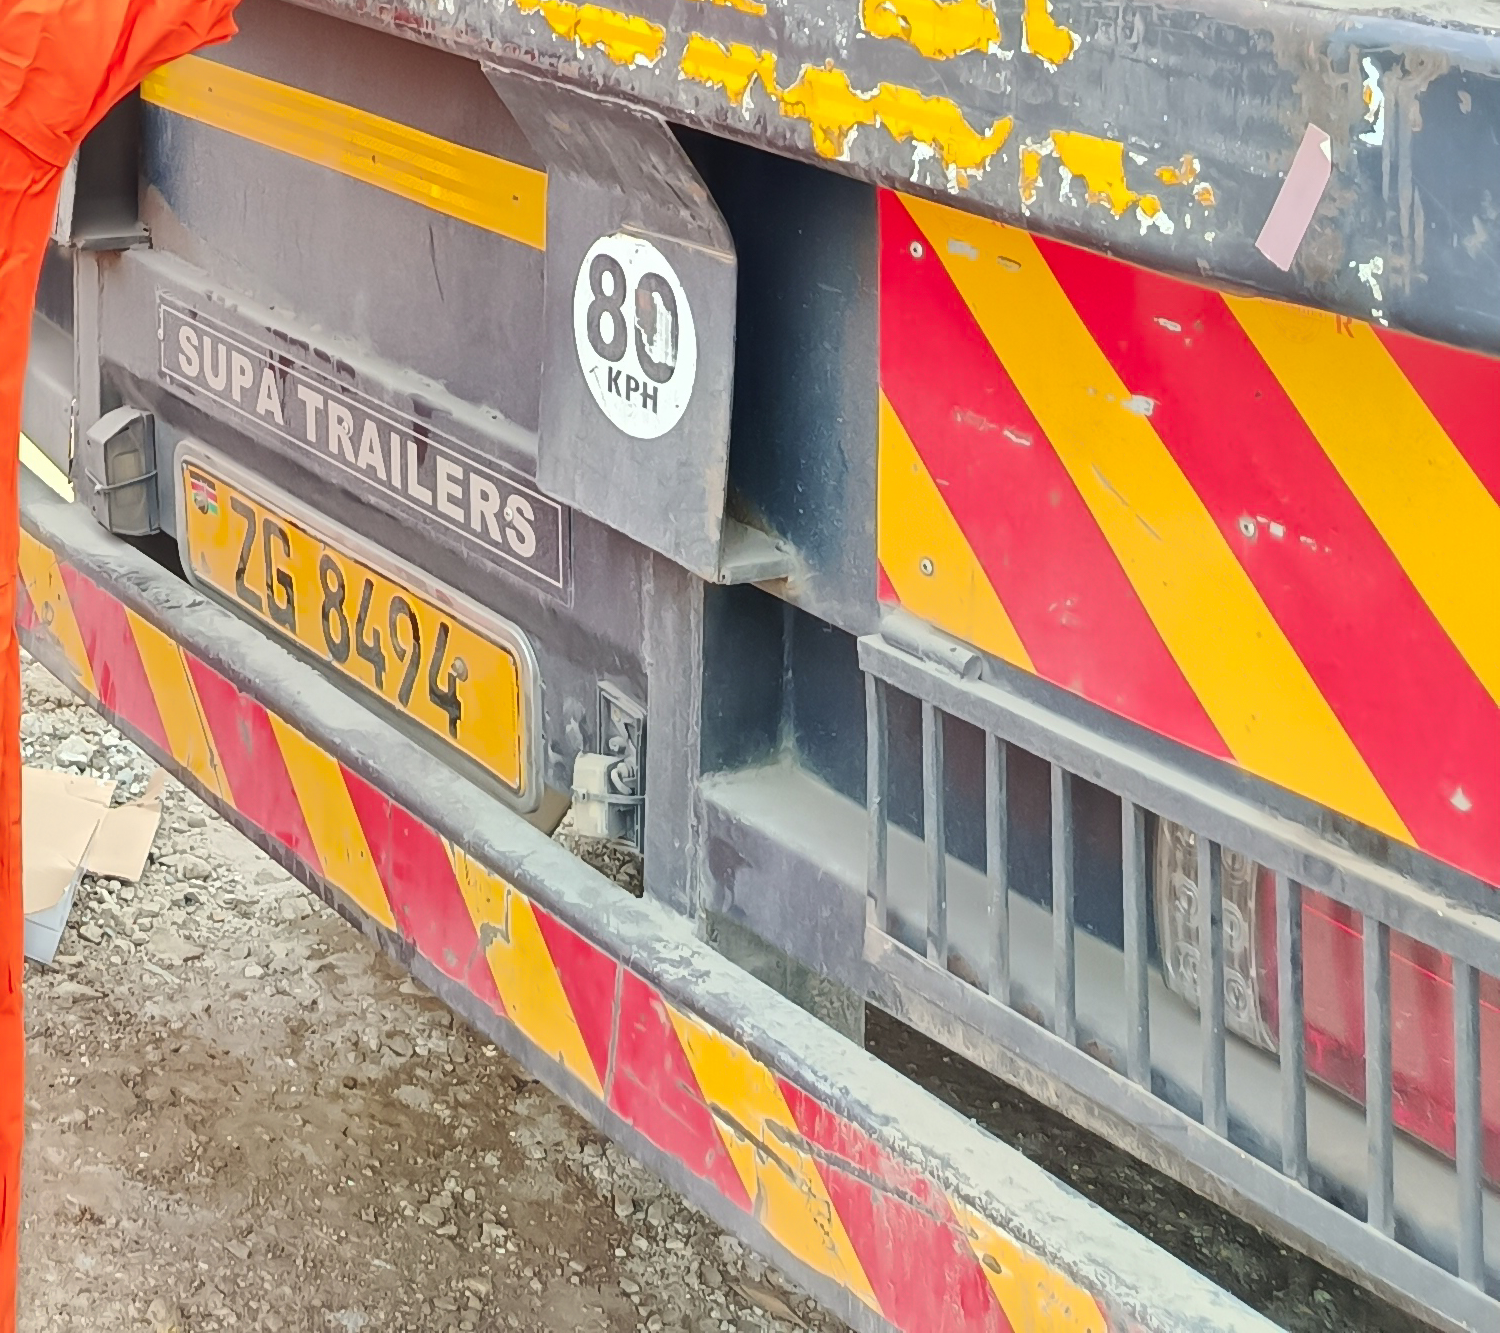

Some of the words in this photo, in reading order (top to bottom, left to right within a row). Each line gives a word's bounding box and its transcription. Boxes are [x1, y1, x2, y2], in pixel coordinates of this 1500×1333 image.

[586, 253, 680, 384] 80
[607, 366, 660, 415] KPH
[177, 324, 285, 426] SUPA
[297, 384, 537, 559] TRAILERS
[229, 497, 298, 635] ZG
[319, 554, 468, 741] 8494
